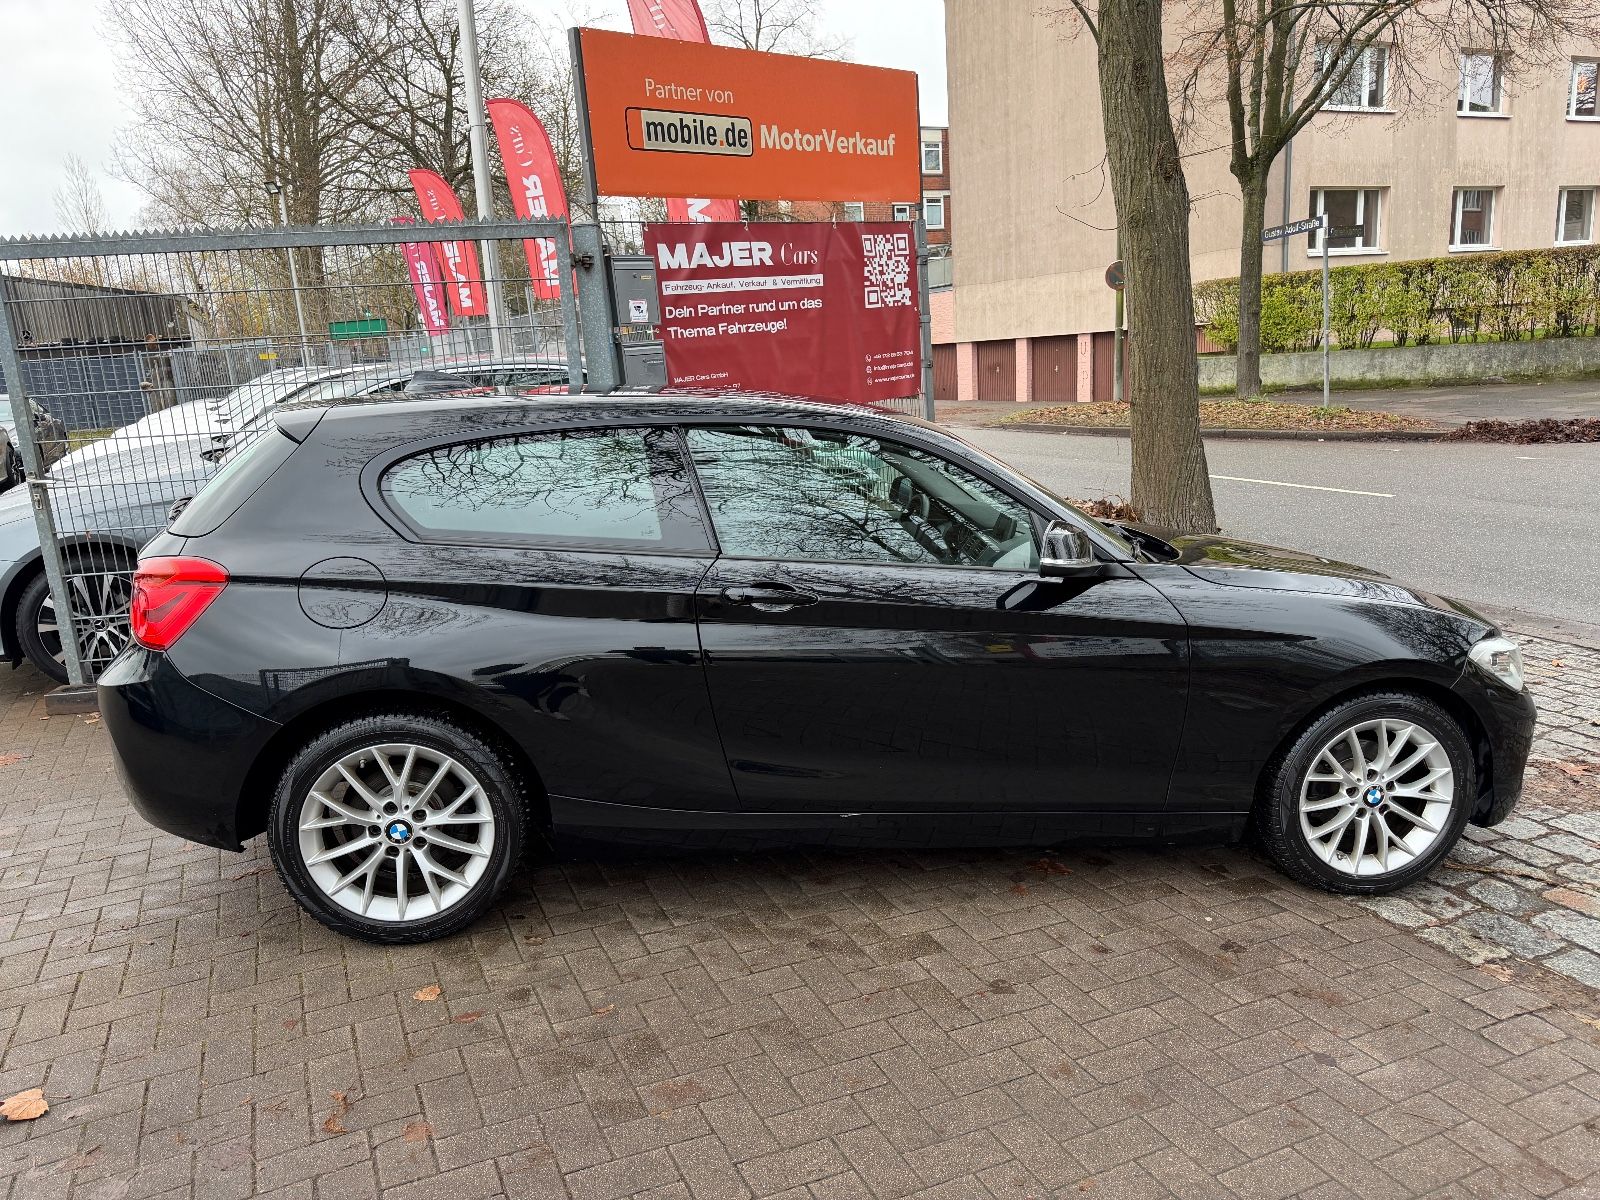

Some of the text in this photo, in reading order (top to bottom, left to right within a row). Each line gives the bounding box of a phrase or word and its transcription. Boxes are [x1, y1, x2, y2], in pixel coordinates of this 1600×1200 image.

[645, 78, 734, 104] Partner von
[645, 119, 748, 149] mobile.de
[760, 124, 896, 157] MotorVerkauf
[656, 240, 818, 270] MAJER Cars
[738, 279, 768, 288] Verkauf
[780, 277, 821, 286] Vermittlung
[665, 297, 822, 319] Dein Partner rund um das
[667, 318, 788, 340] Thema Fahrzeuge!
[673, 376, 695, 384] MAJER
[710, 371, 729, 379] GmbH
